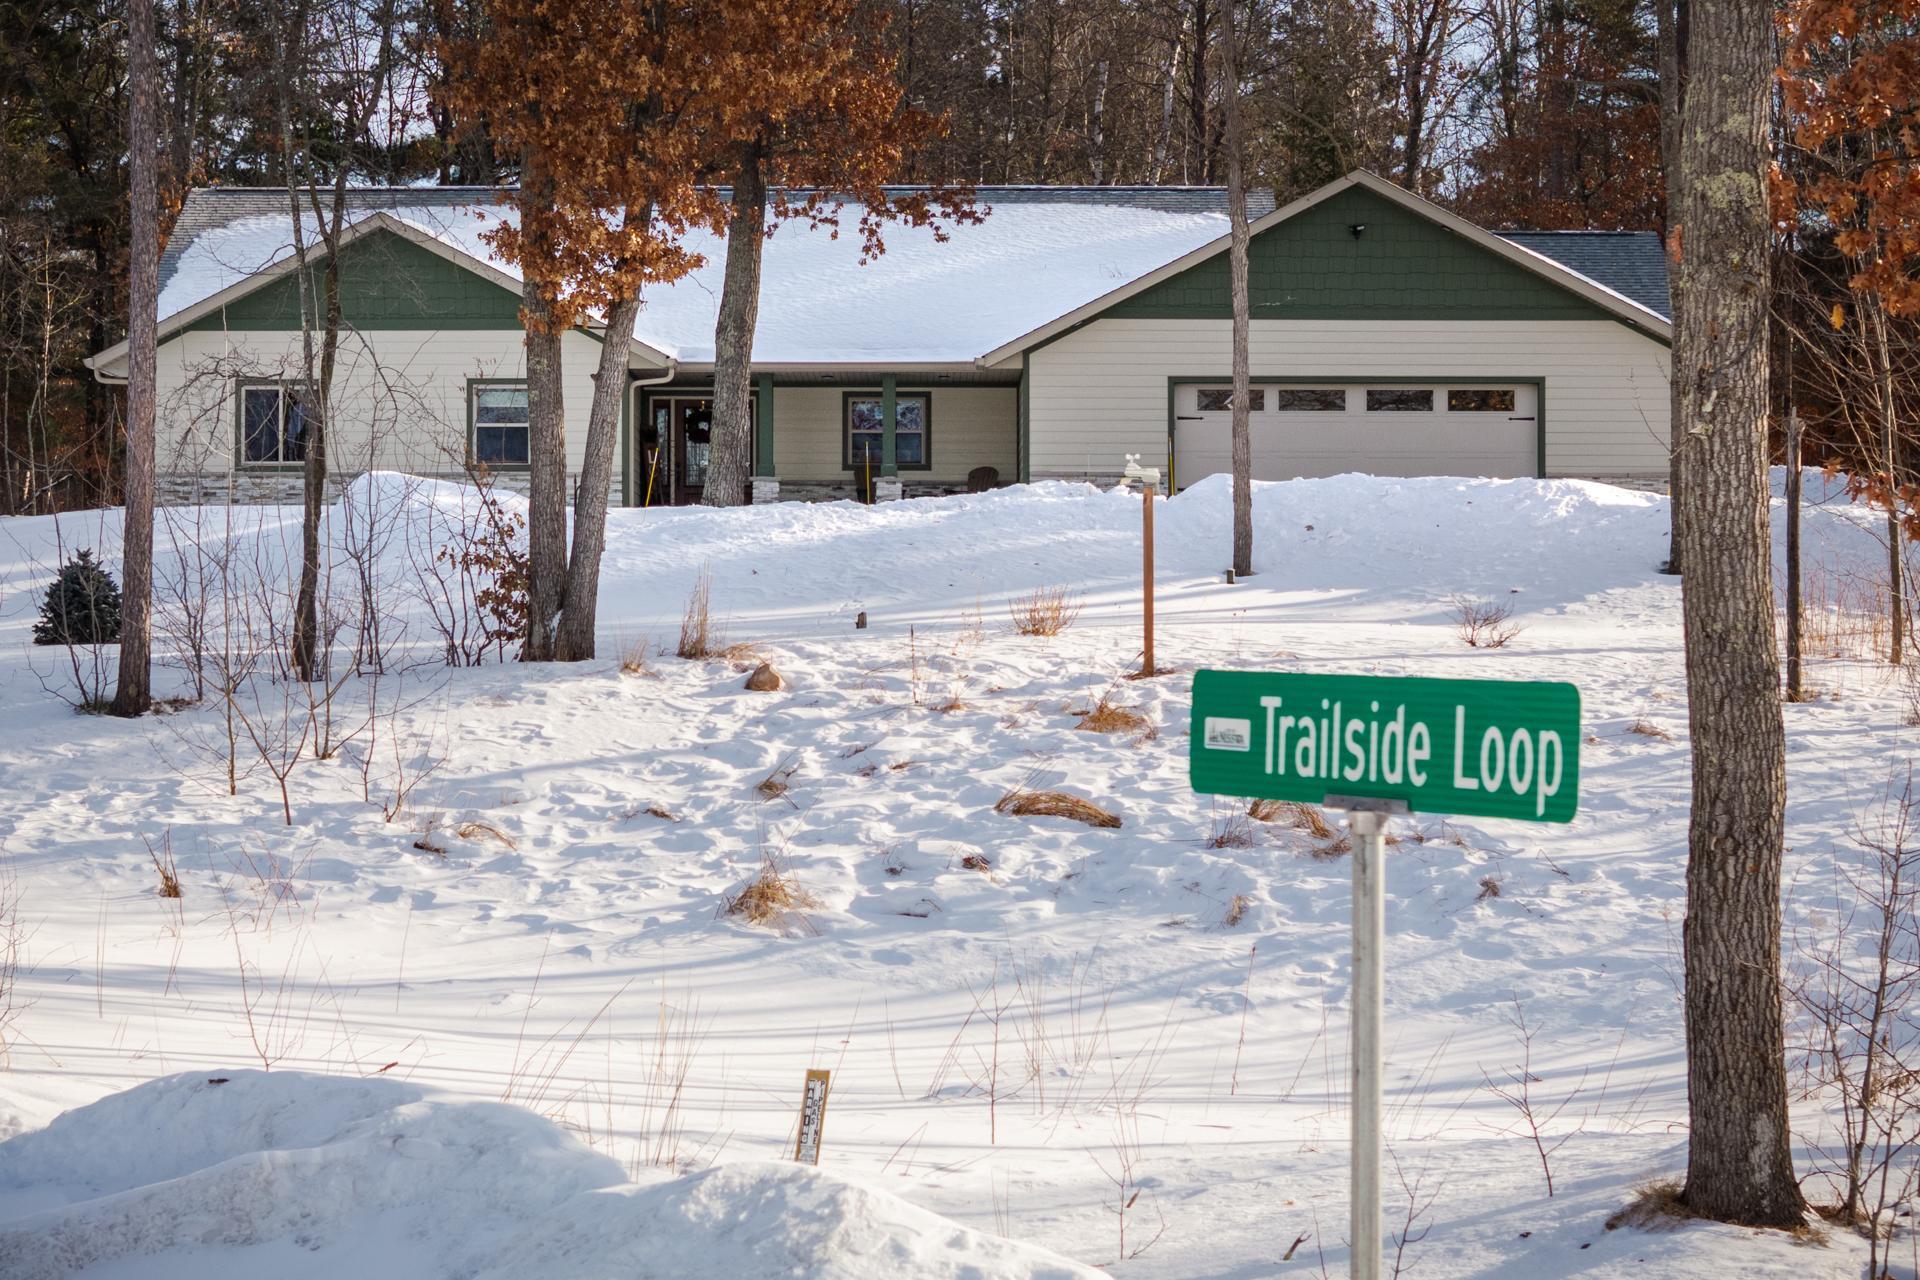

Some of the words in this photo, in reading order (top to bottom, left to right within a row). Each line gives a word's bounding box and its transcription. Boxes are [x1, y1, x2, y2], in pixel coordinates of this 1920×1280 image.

[1260, 696, 1431, 787] Trailside
[1453, 704, 1563, 817] Loop
[801, 1080, 815, 1143] WARNING
[810, 1100, 818, 1125] GAS
[813, 1081, 825, 1144] PIPELINE
